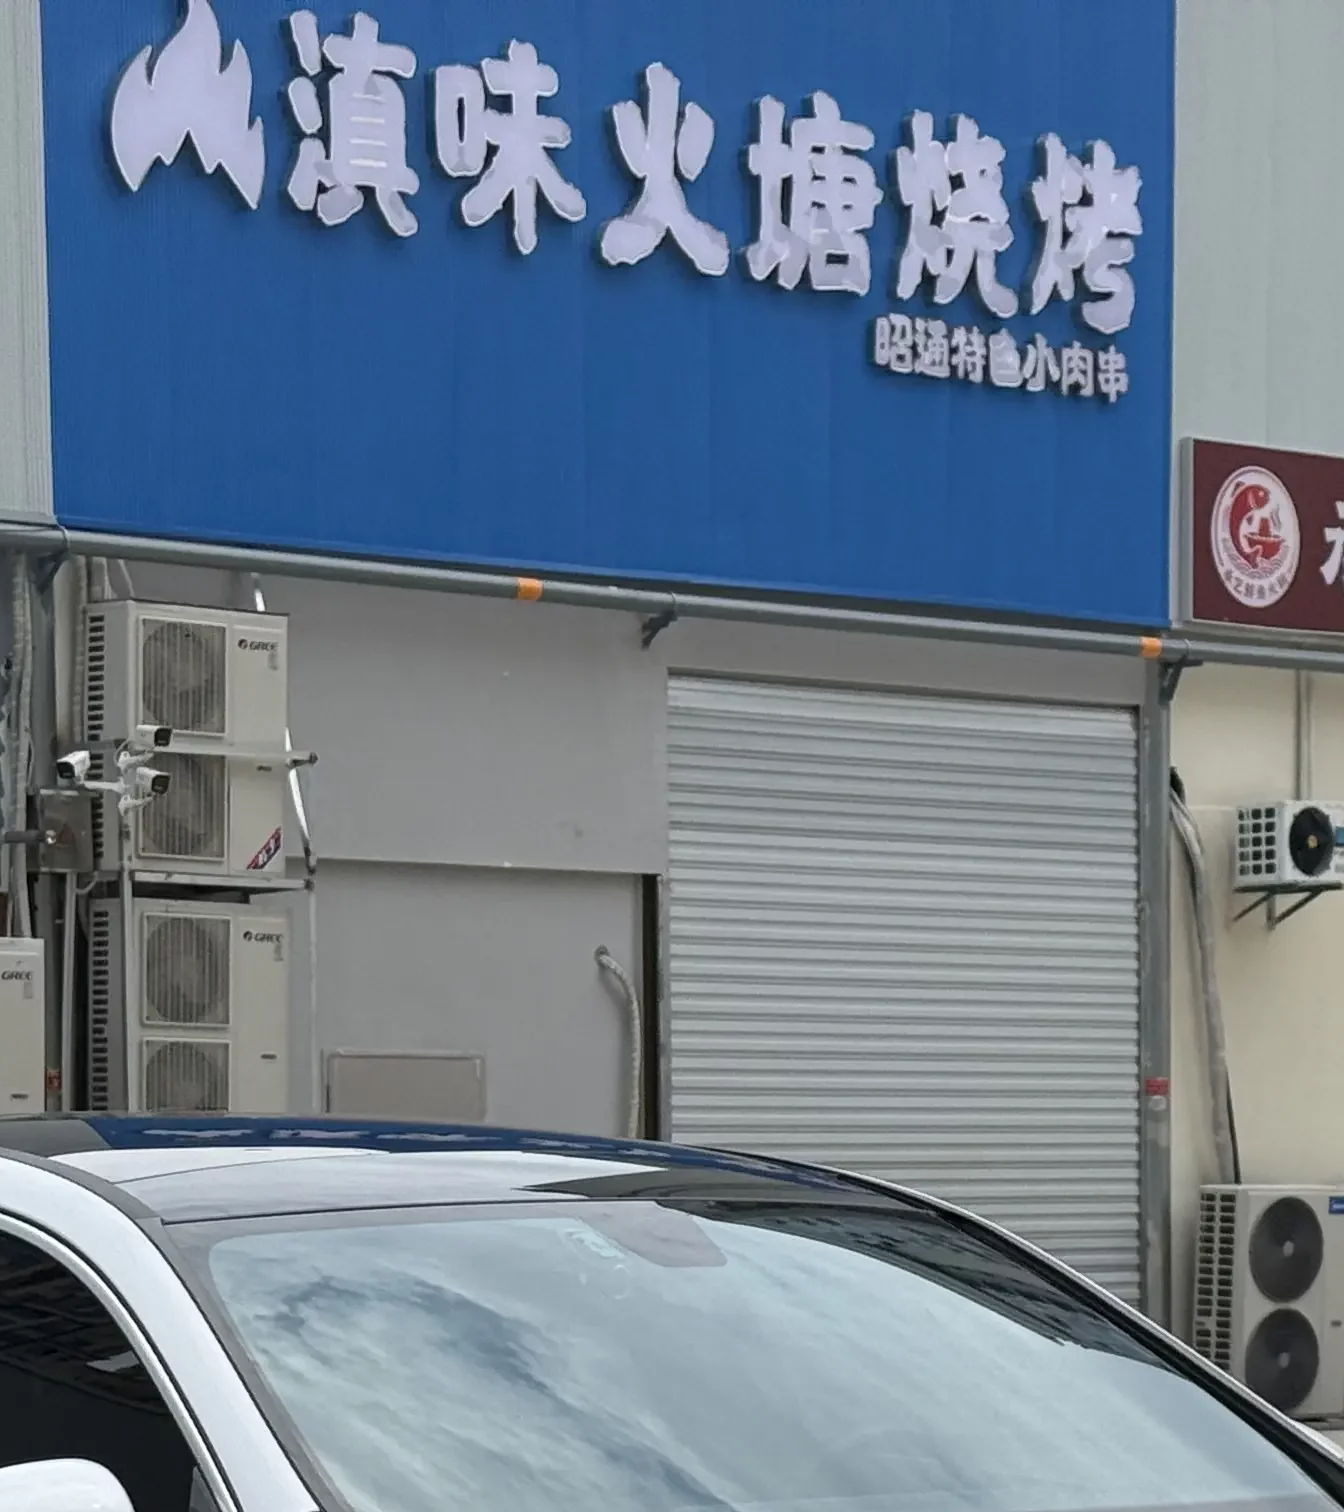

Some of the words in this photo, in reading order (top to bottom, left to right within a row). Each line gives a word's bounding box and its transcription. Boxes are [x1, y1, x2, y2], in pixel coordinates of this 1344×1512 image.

[285, 9, 1144, 335] 滇味火塘烧烤
[874, 313, 1130, 402] 昭通特色小肉串
